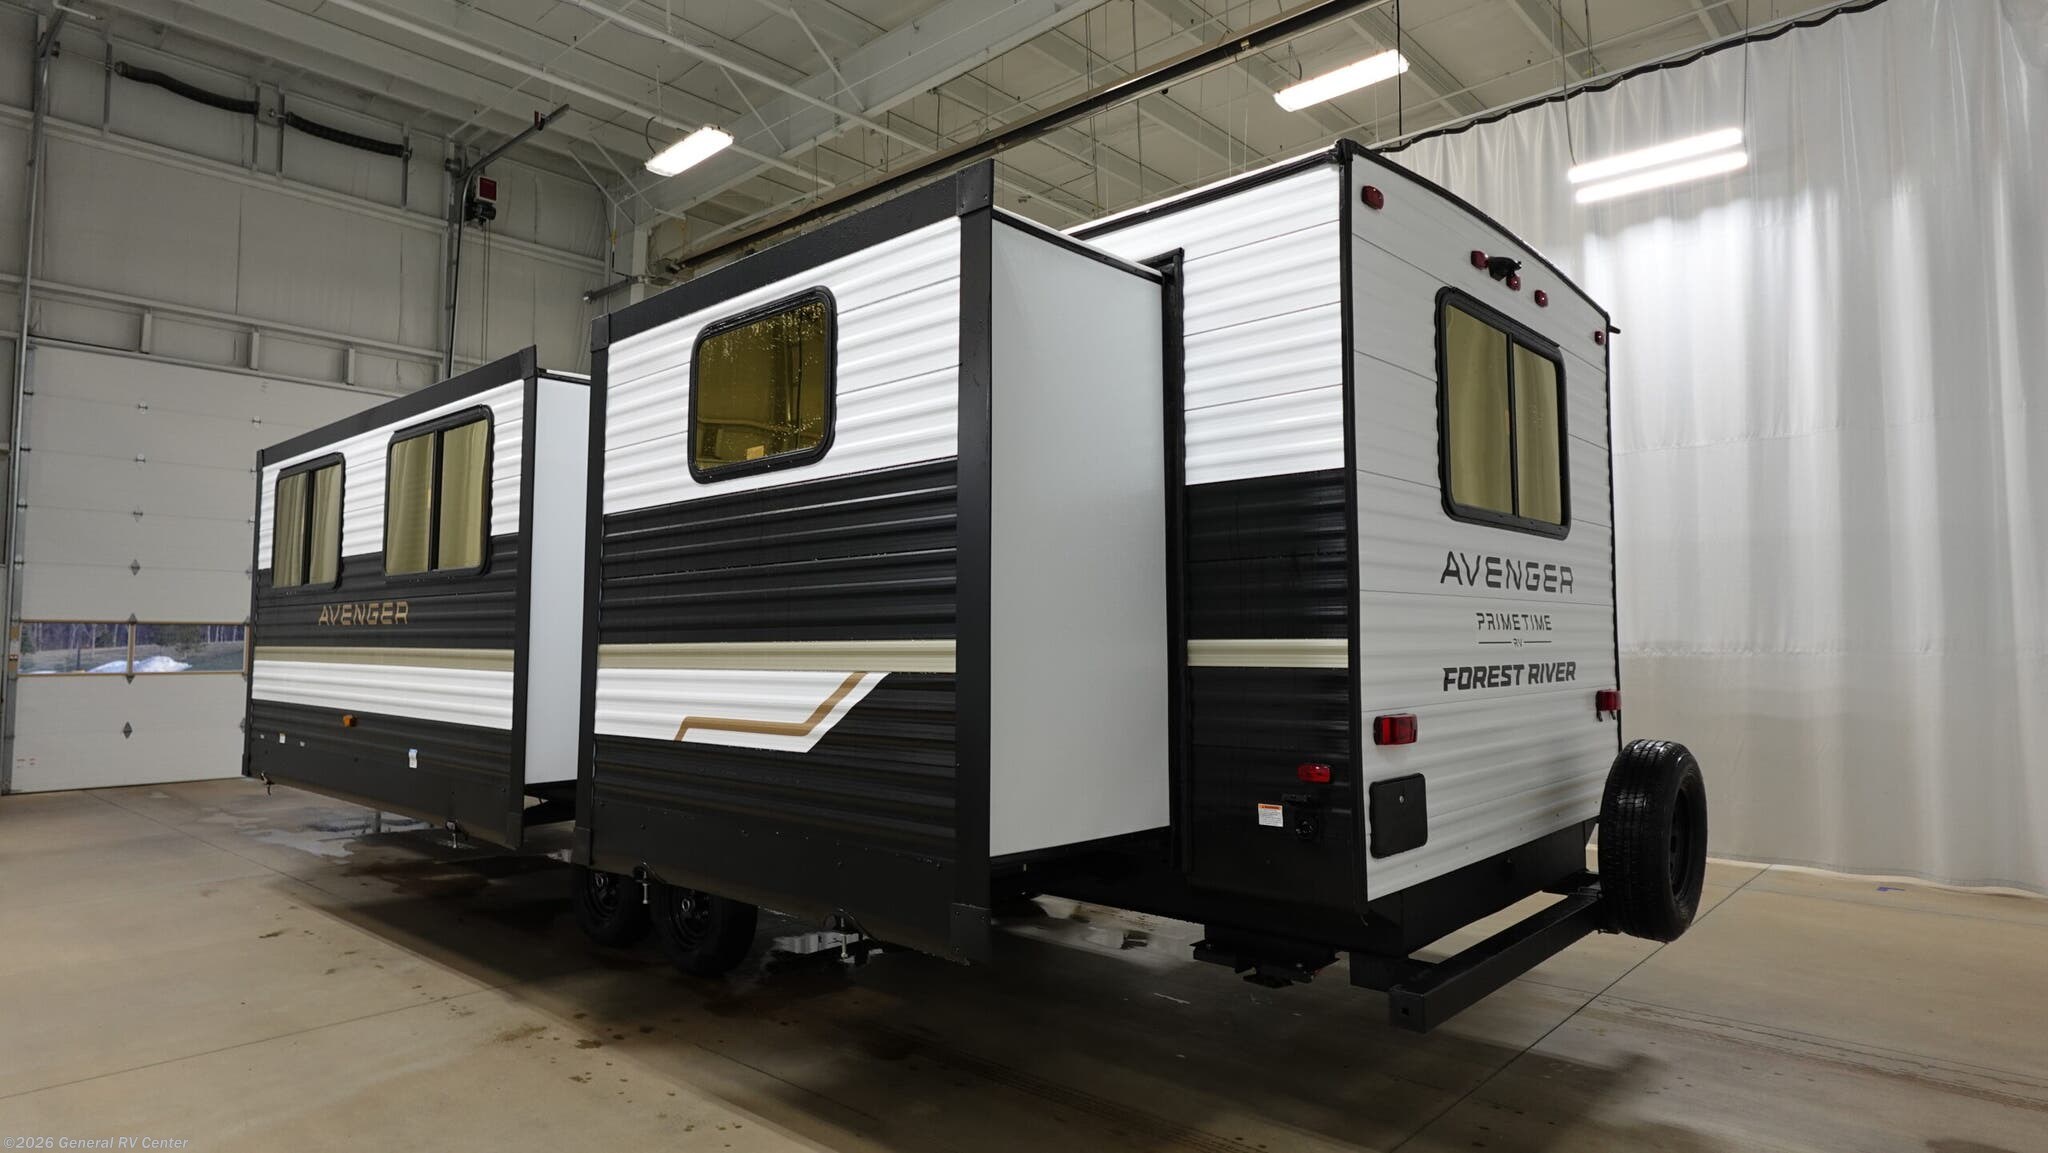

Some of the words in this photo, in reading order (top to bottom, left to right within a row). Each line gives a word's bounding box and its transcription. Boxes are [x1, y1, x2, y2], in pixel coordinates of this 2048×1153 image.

[1440, 551, 1574, 594] AVENGER
[318, 601, 409, 626] AVENGER
[1513, 638, 1524, 647] RV
[1443, 664, 1525, 692] FOREST
[1527, 661, 1576, 685] RIVER
